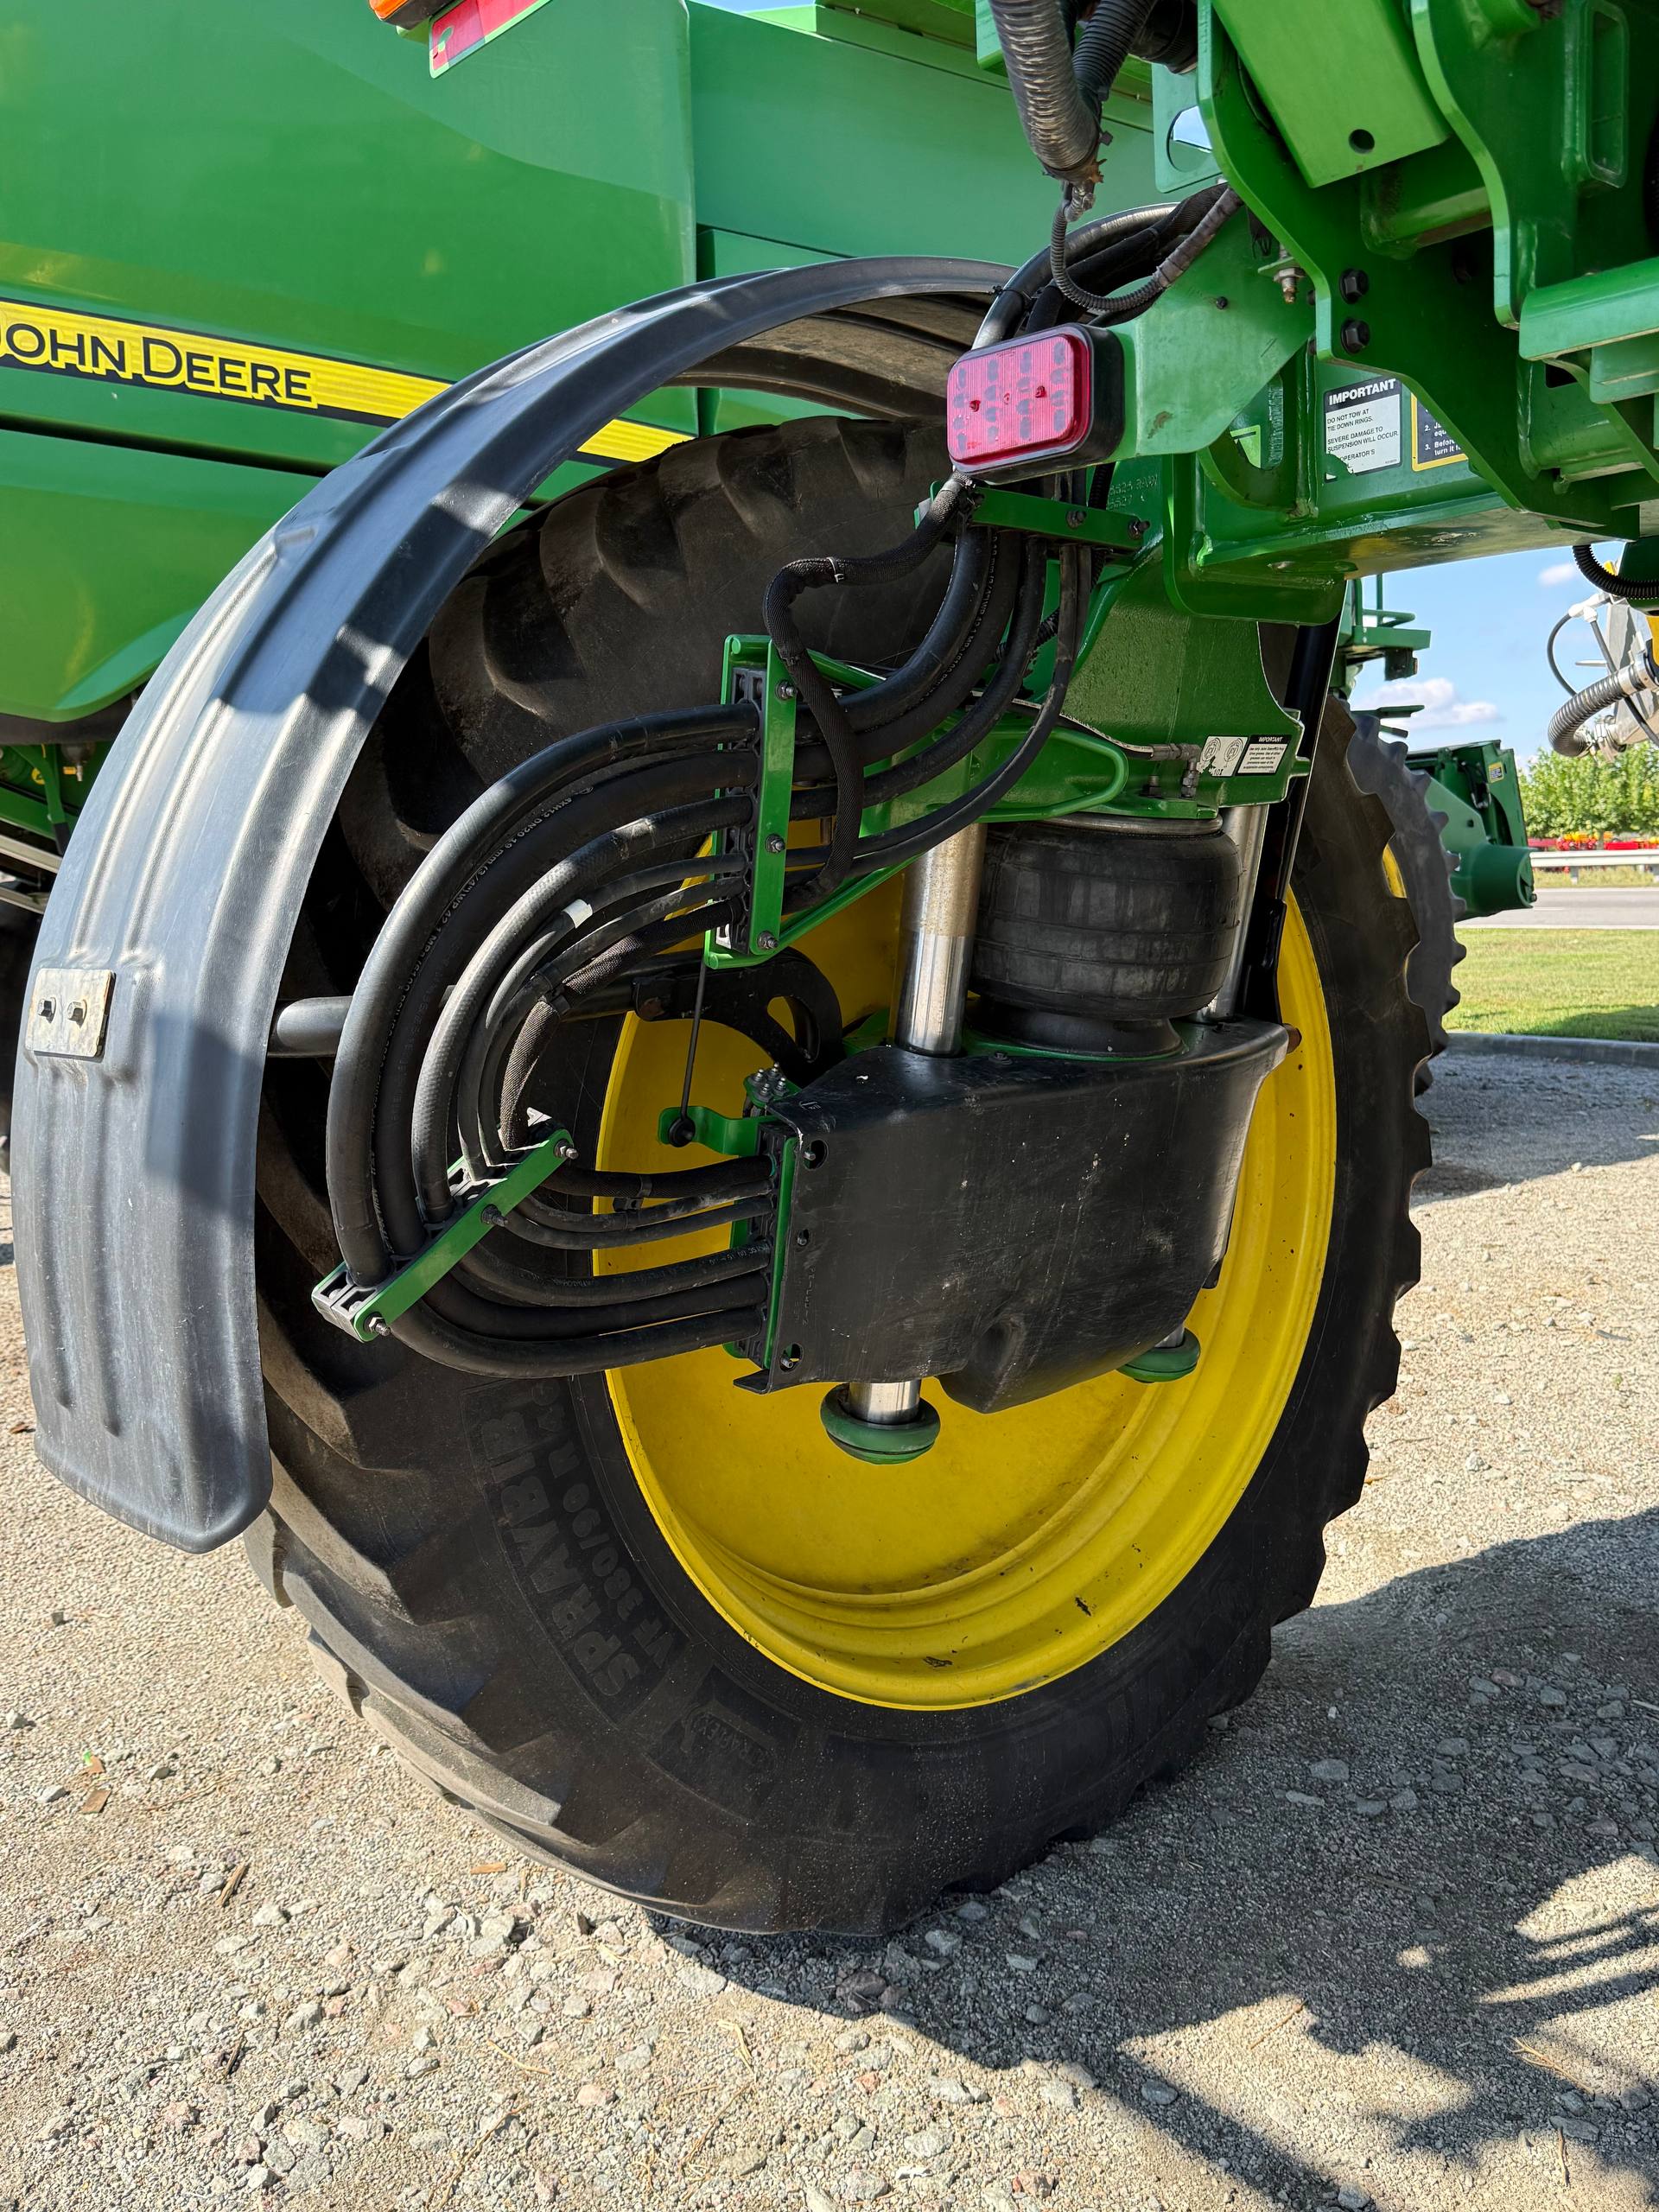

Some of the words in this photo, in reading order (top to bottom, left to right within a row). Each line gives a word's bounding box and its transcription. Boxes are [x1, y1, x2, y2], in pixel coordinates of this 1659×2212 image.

[0, 323, 124, 372] OHN
[143, 336, 312, 402] DEERE
[1329, 378, 1396, 406] IMPORTANT
[1337, 421, 1353, 430] DOWN
[1355, 416, 1374, 425] RINGS.
[1327, 434, 1349, 445] SEVERE
[1351, 428, 1374, 439] DAMAGE
[1327, 439, 1362, 453] SUSPENSION
[1363, 435, 1376, 444] WILL
[516, 817, 543, 839] DN20
[504, 836, 518, 850] 19
[486, 848, 505, 866] mm
[450, 892, 466, 910] WP
[418, 933, 437, 958] MPa
[548, 1442, 580, 1479] R
[481, 1412, 640, 1696] SPRAYBIB
[562, 1484, 645, 1622] 380/90
[631, 1618, 676, 1669] VF
